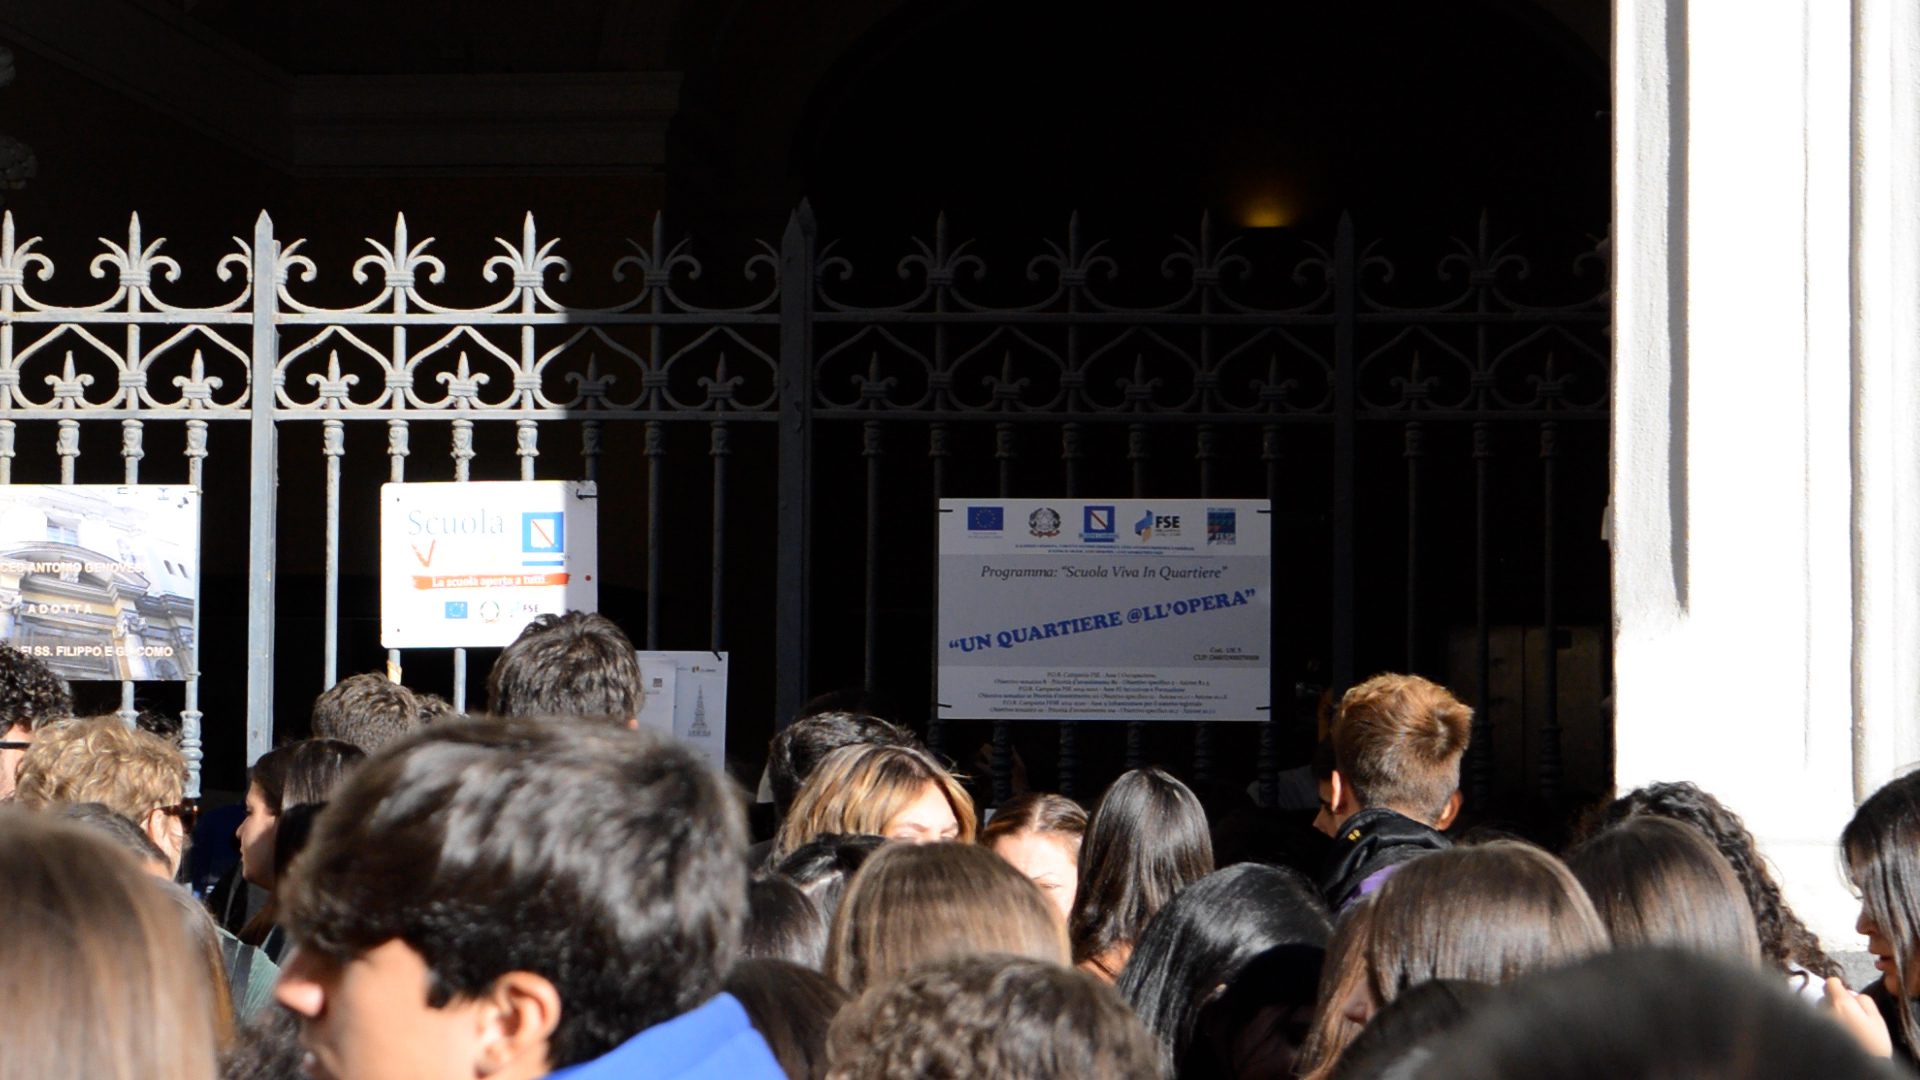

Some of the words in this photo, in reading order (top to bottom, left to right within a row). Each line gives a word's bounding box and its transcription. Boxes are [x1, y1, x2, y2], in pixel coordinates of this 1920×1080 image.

[407, 508, 505, 536] Scuola
[1155, 515, 1180, 529] FSE
[30, 562, 82, 574] ANTONIO
[84, 562, 147, 574] GENOVES
[980, 566, 1058, 581] Programma:
[1112, 566, 1140, 579] Viva
[1143, 566, 1156, 579] In
[432, 576, 445, 587] La
[446, 576, 478, 587] scuola
[996, 611, 1123, 649] QUARTIERE
[34, 646, 54, 656] SS.
[56, 646, 101, 657] FILIPPO
[105, 646, 113, 656] E
